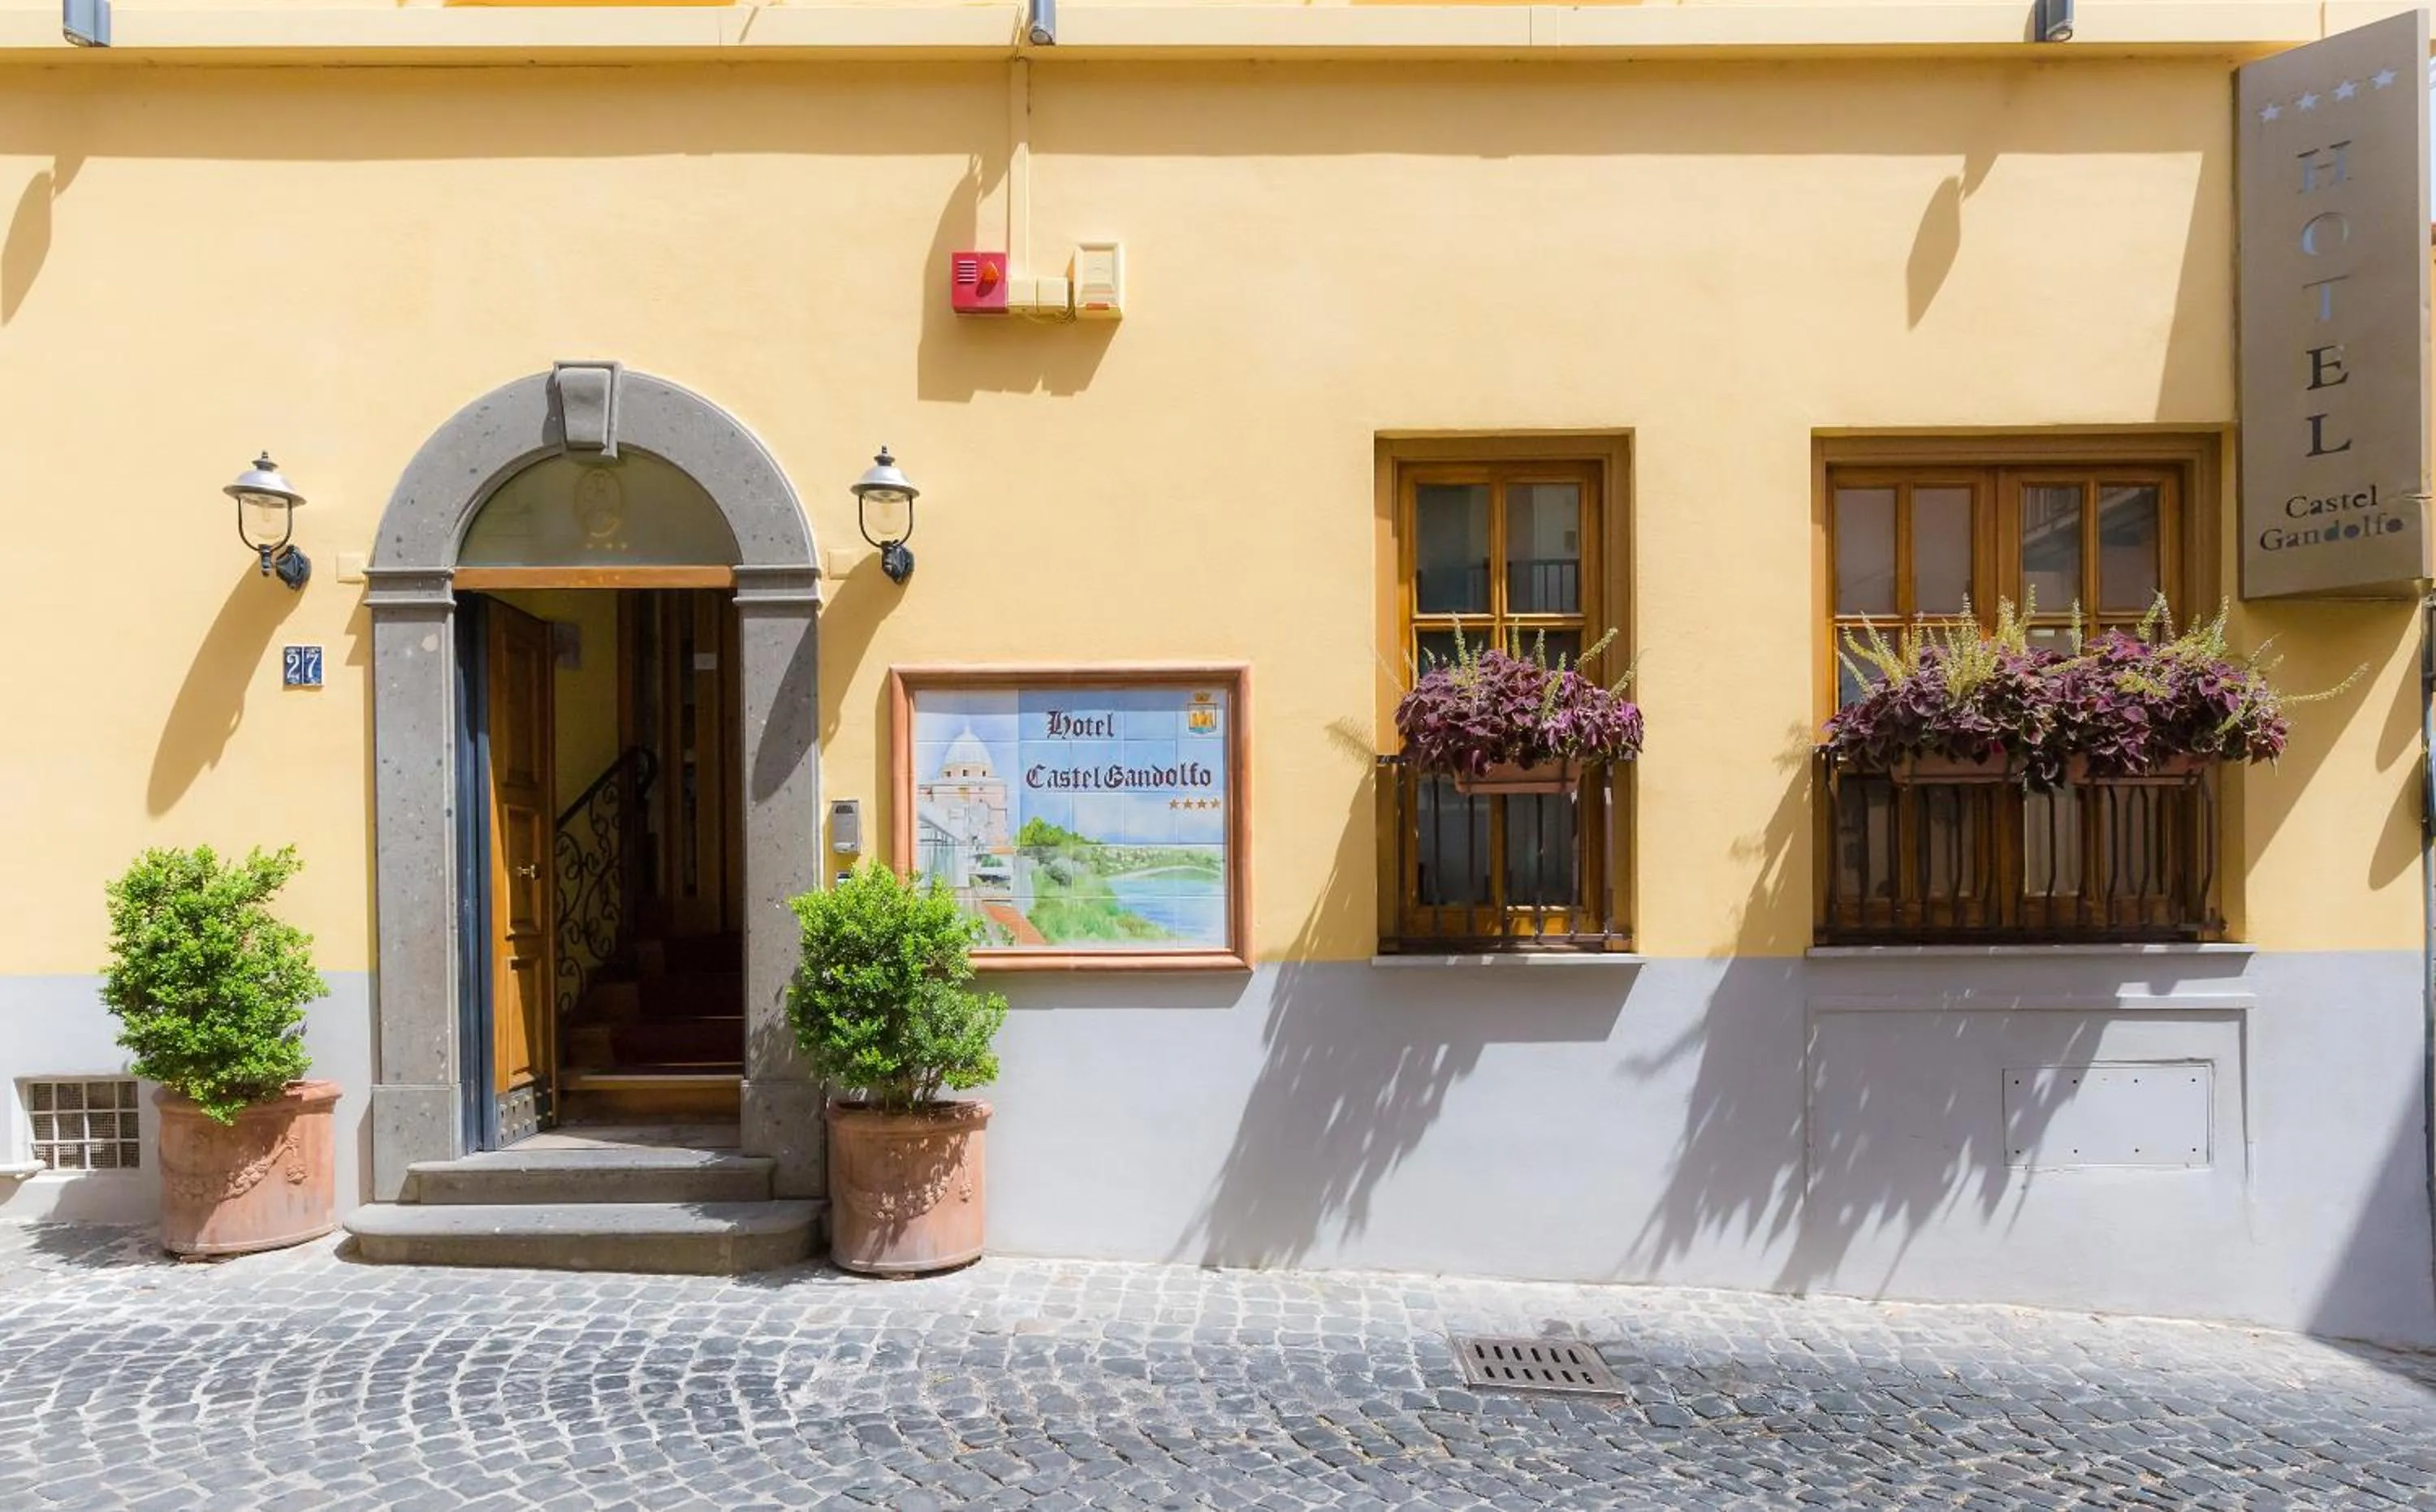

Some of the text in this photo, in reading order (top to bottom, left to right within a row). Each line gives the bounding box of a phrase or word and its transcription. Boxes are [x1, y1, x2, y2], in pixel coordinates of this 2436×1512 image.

[2296, 139, 2353, 459] HOTEL
[2285, 484, 2379, 520] Castel
[2259, 512, 2404, 551] Gandolfo
[286, 653, 319, 680] 27
[1046, 711, 1115, 740] Hotel
